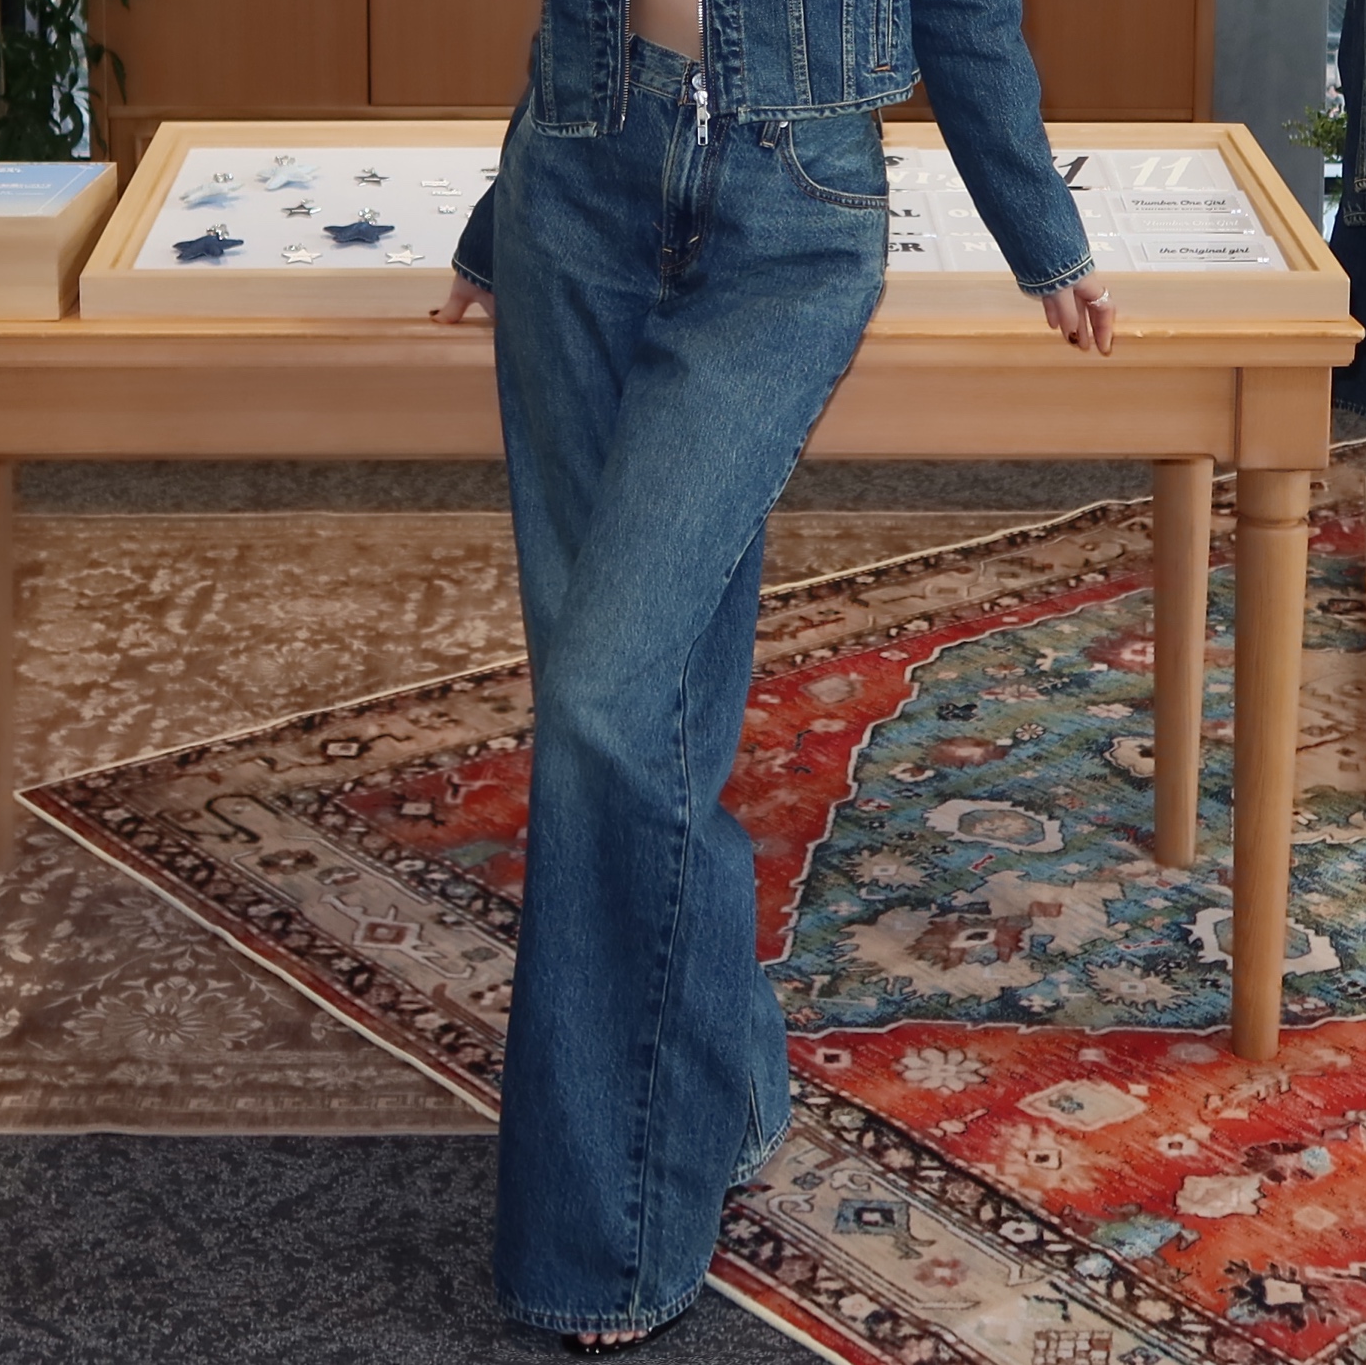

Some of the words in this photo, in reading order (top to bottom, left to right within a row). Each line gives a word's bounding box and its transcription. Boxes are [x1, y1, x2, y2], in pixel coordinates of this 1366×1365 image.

[1204, 199, 1227, 207] Girl
[1179, 247, 1227, 255] Original
[1228, 247, 1250, 255] girl
